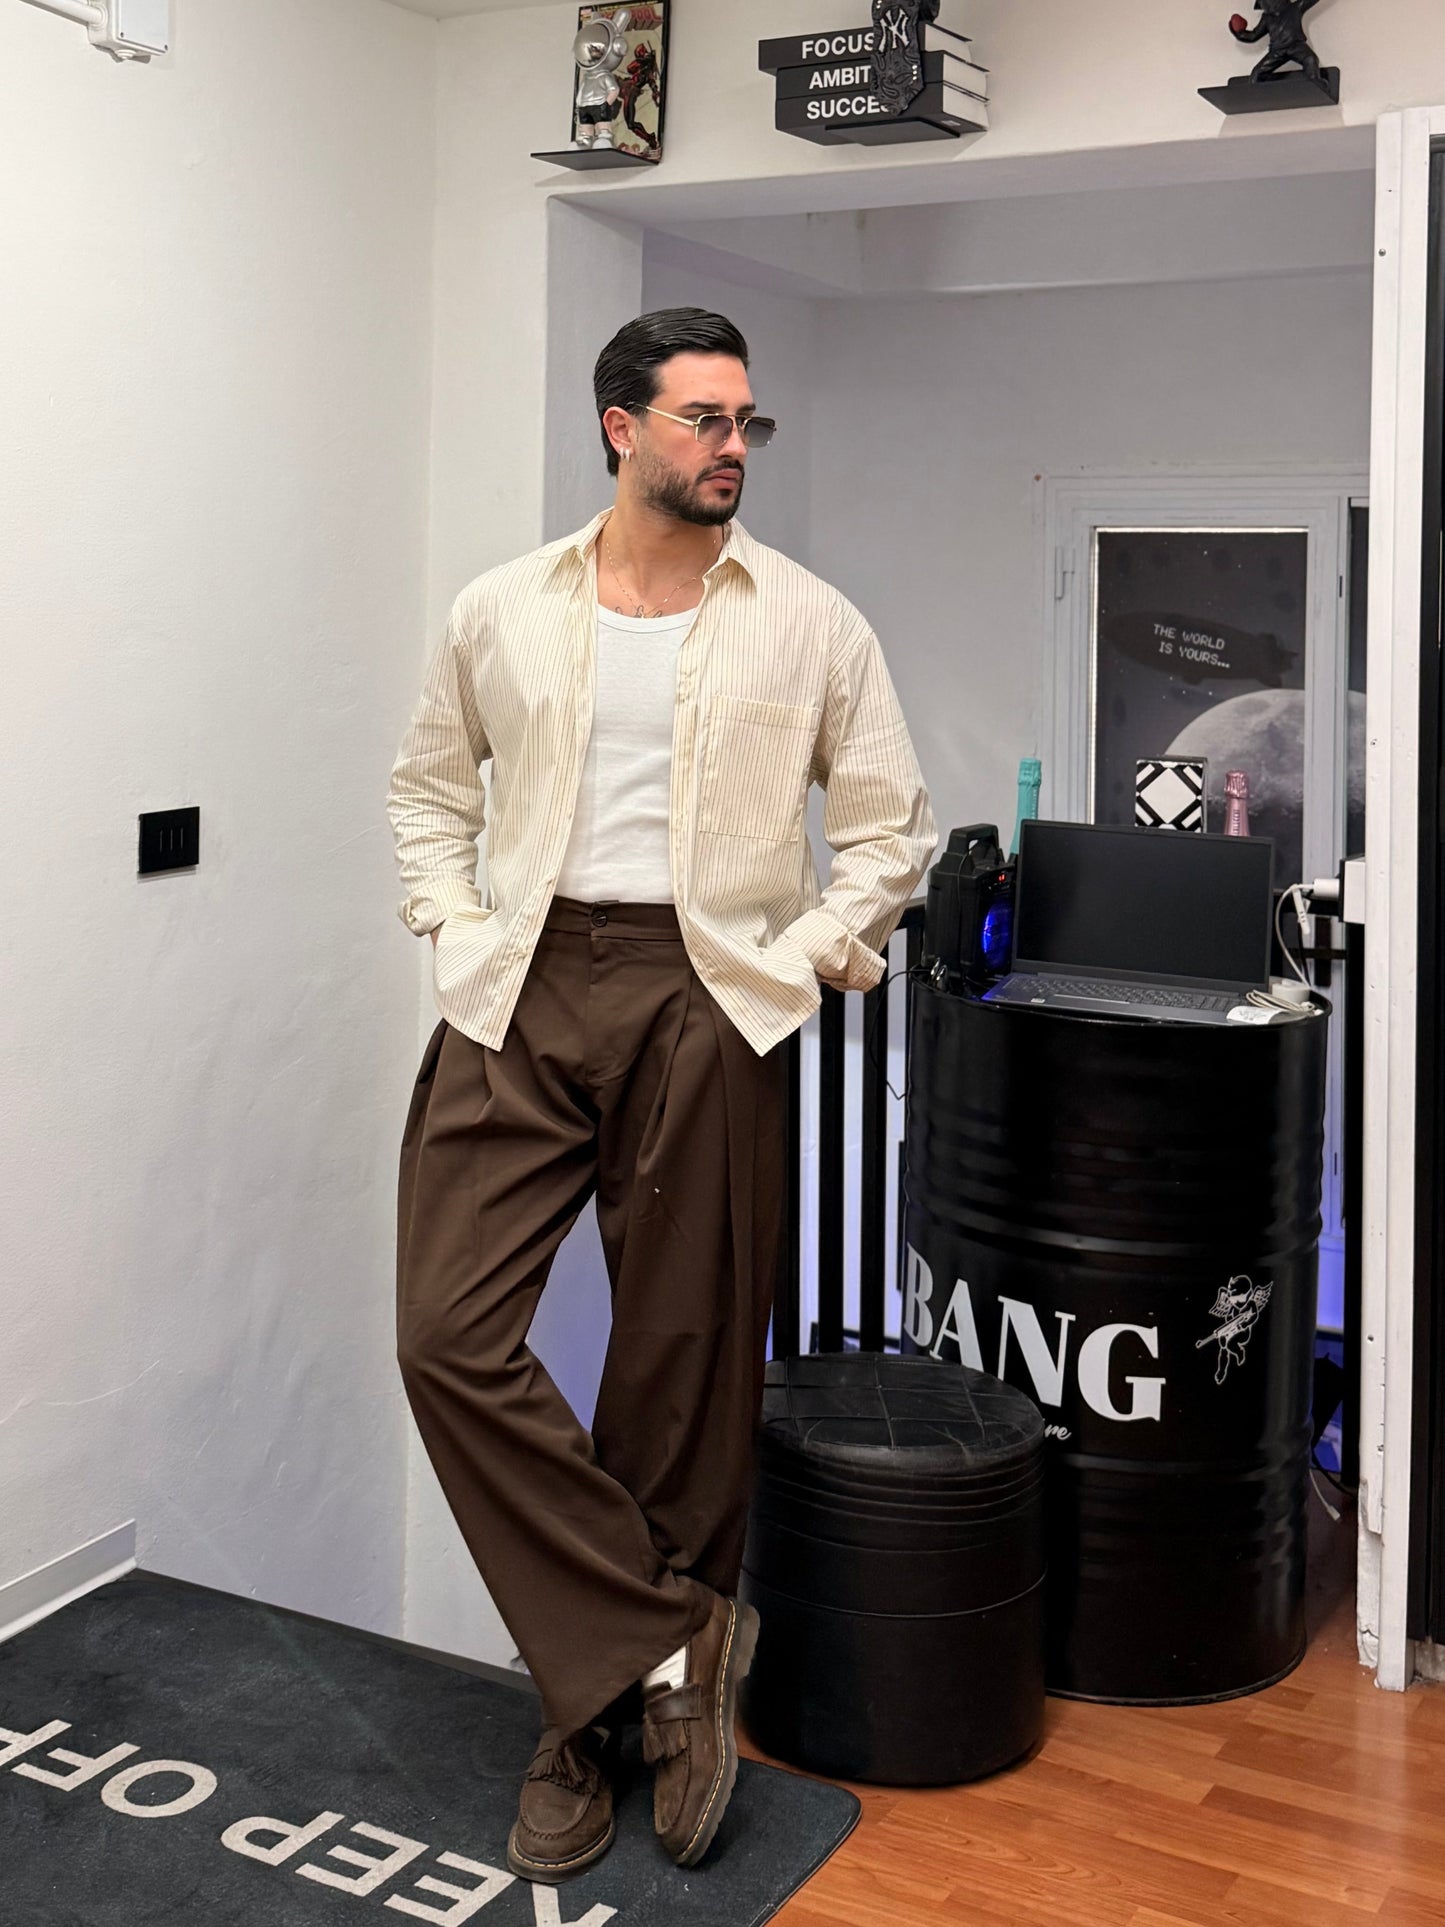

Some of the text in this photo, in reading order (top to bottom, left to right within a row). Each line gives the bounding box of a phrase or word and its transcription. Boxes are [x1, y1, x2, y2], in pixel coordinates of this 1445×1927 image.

[801, 32, 875, 60] FOCUS
[808, 65, 872, 90] AMBIT
[806, 95, 889, 120] SUCCE
[1153, 623, 1226, 651] THE WORLD
[1158, 641, 1231, 669] IS YOURS...
[903, 1241, 1166, 1422] BANG
